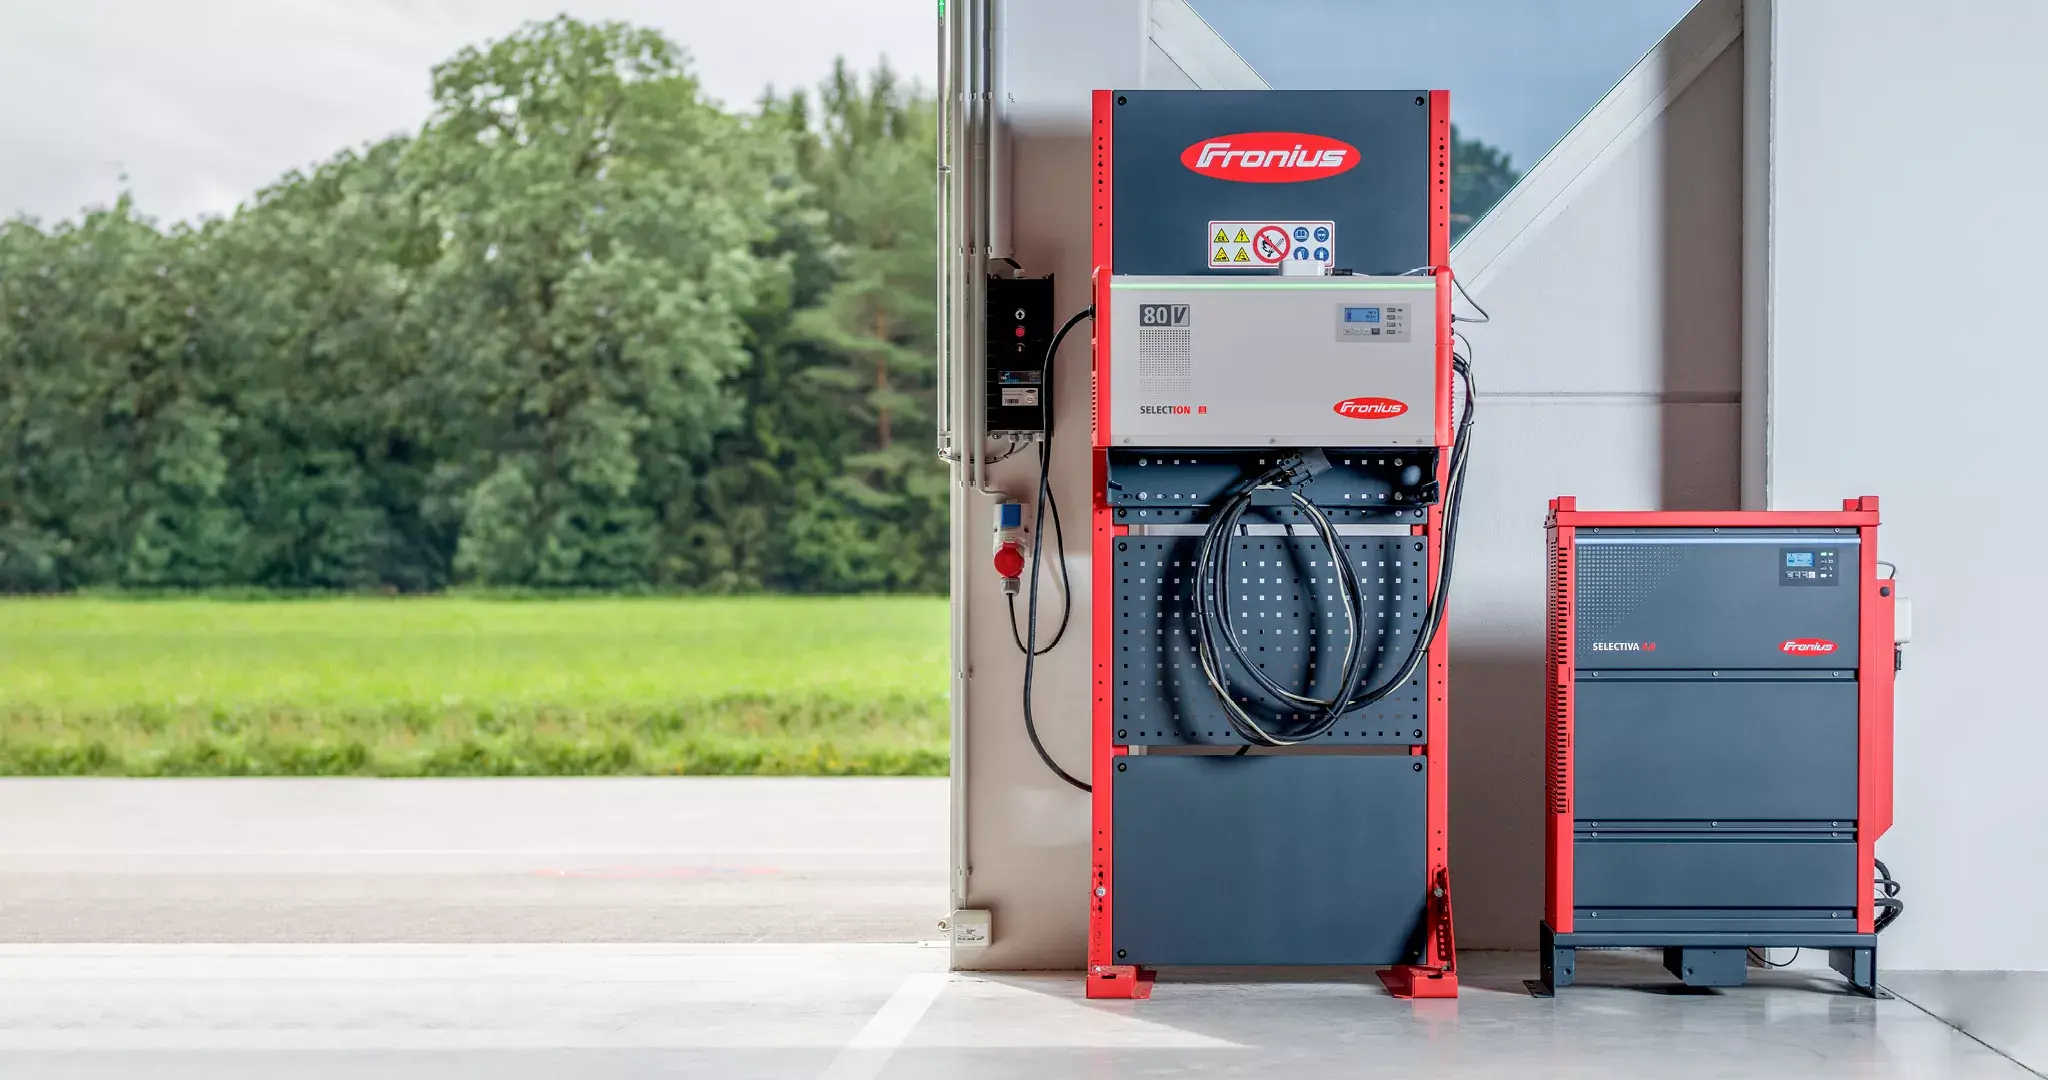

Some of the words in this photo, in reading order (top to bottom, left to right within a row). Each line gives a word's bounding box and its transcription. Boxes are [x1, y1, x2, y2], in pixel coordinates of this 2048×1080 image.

[1195, 142, 1347, 168] Fronius
[1140, 405, 1191, 415] SELECTION
[1340, 401, 1402, 413] Fronius
[1592, 642, 1640, 651] SELECTIVA
[1783, 641, 1834, 651] Fronius
